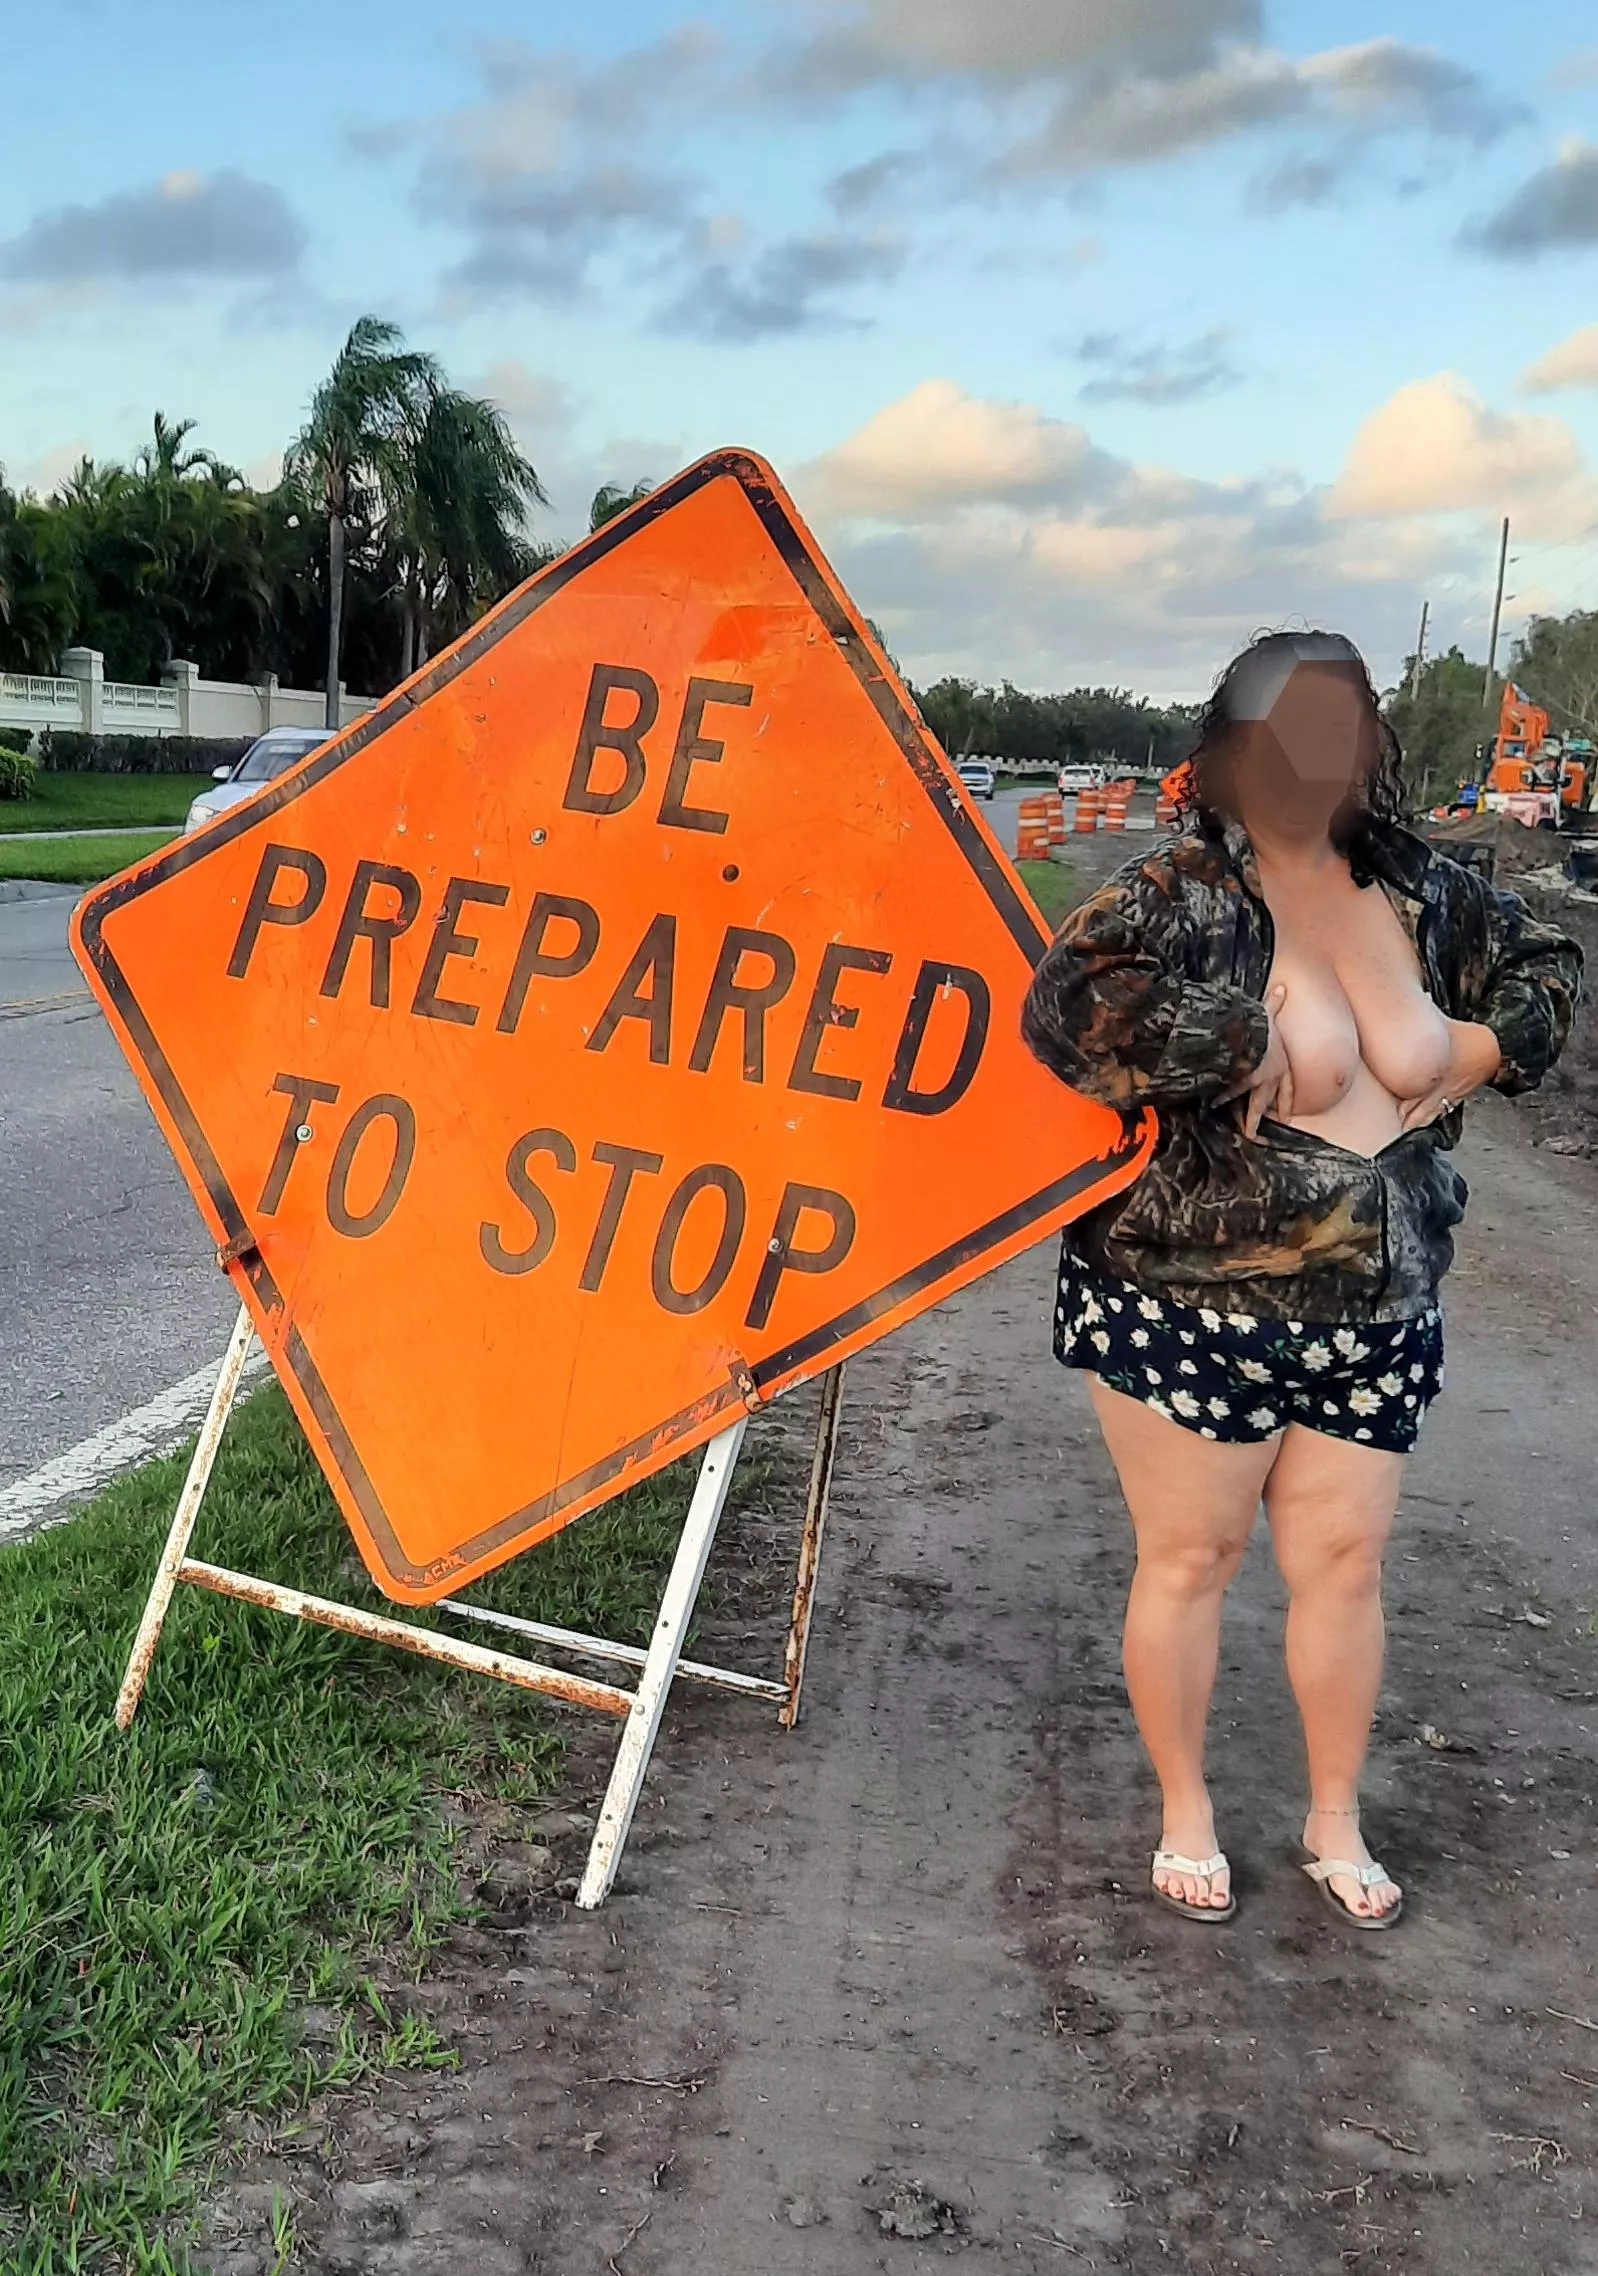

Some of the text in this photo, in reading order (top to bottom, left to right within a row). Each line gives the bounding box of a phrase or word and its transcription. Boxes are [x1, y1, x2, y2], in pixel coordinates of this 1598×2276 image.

[561, 663, 754, 835] BE
[225, 843, 991, 1116] PREPARED
[256, 1072, 856, 1330] TO STOP
